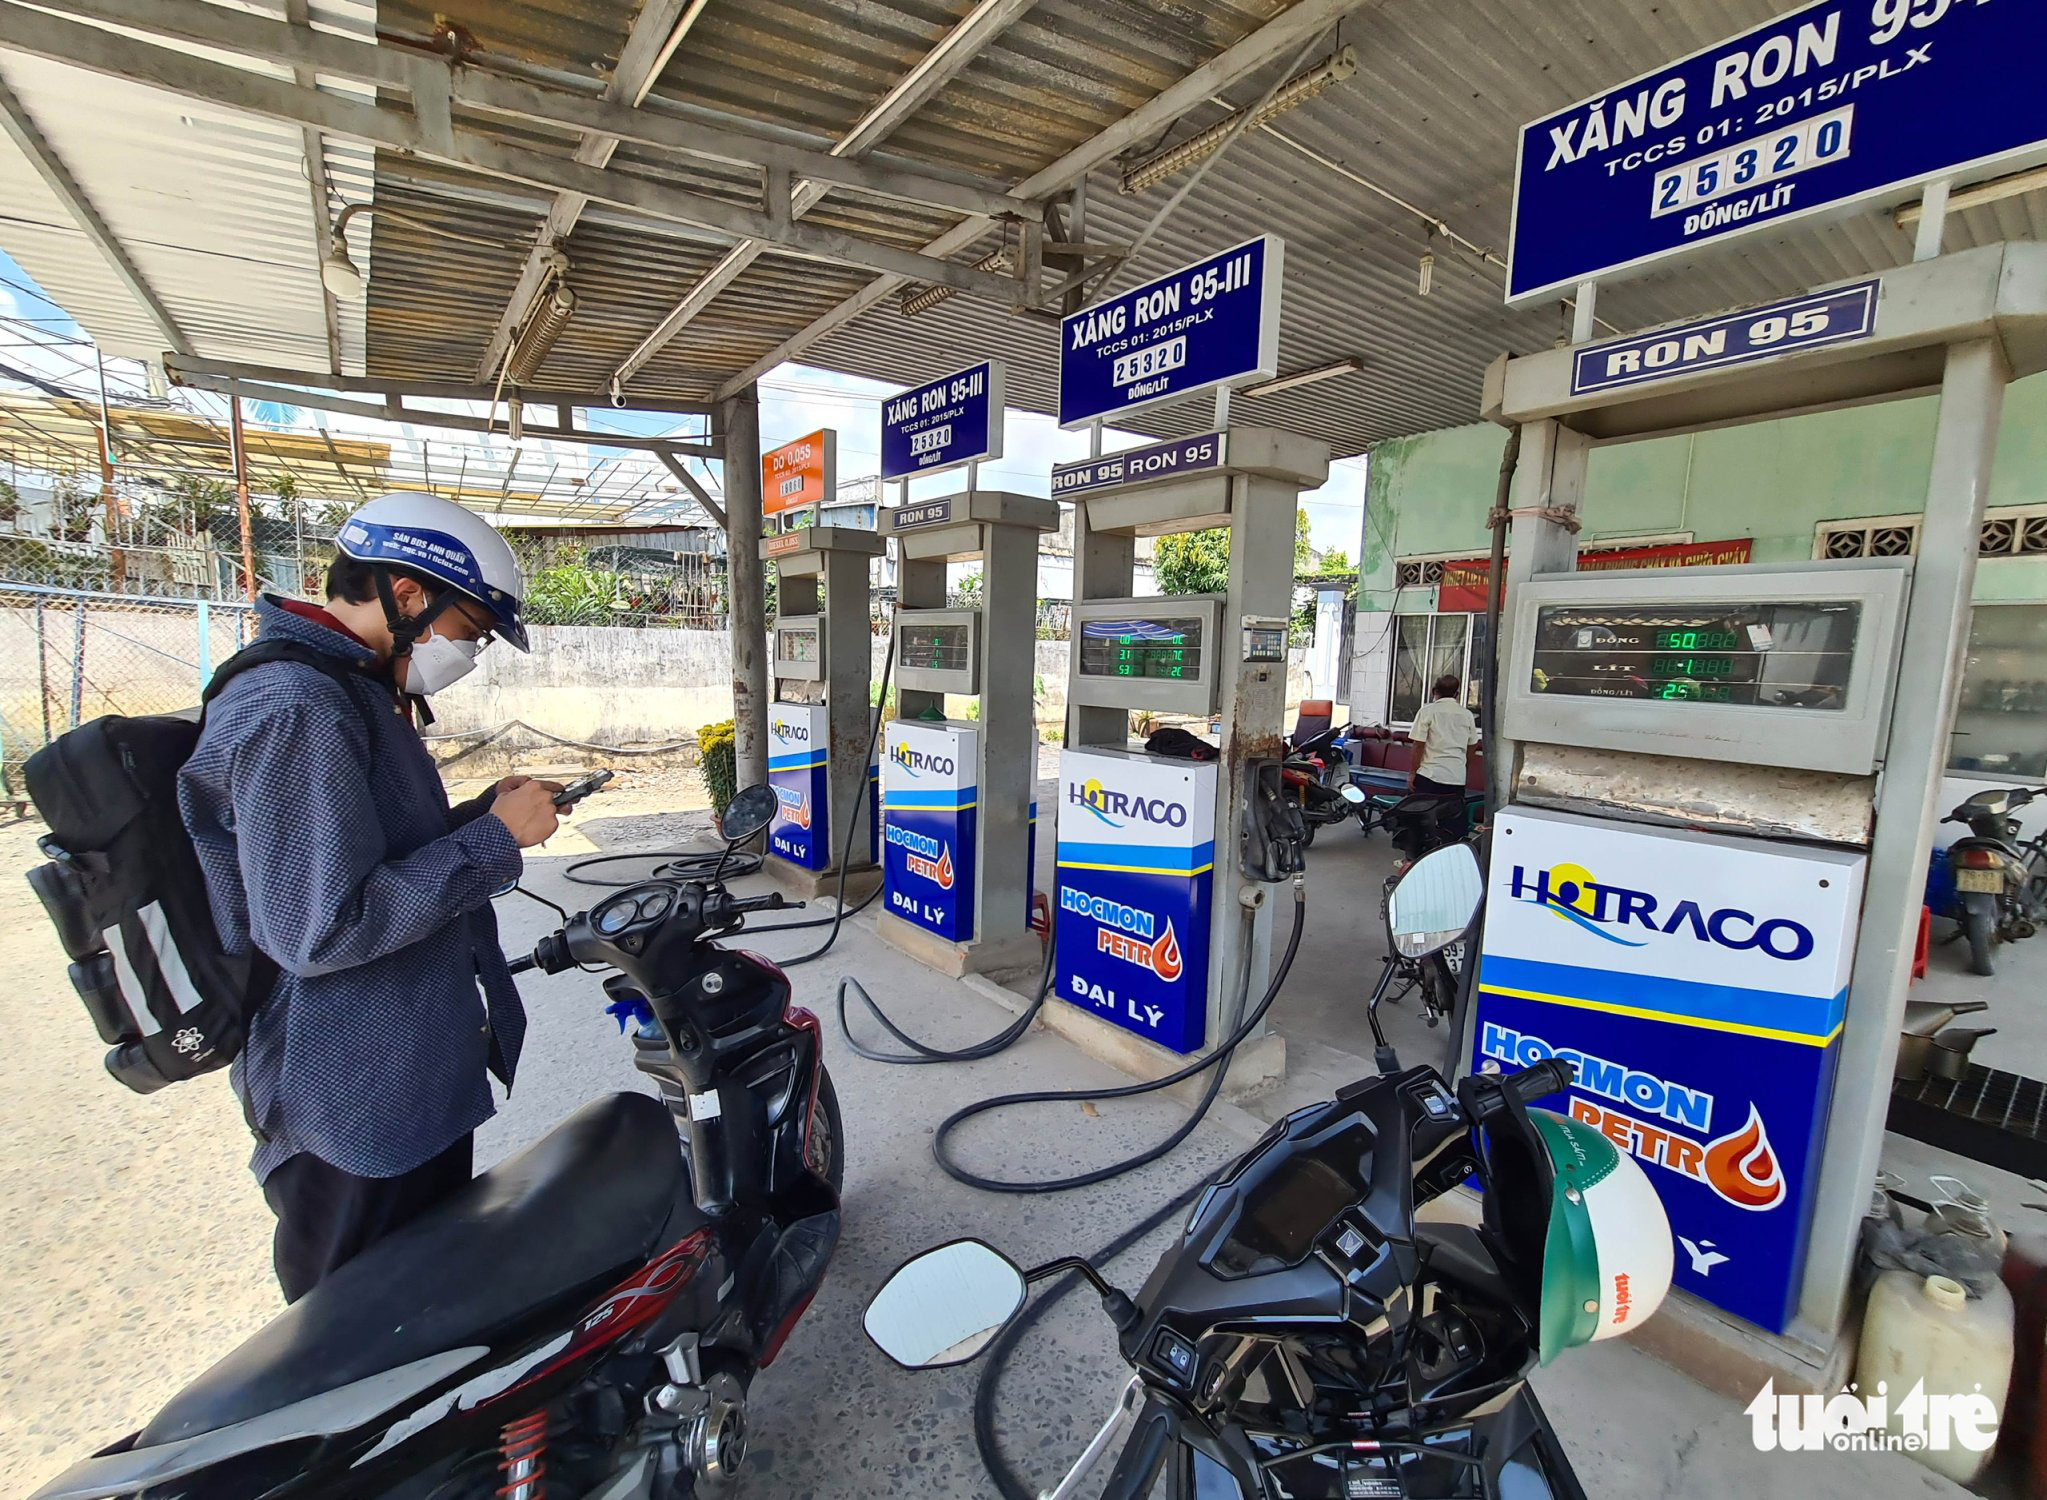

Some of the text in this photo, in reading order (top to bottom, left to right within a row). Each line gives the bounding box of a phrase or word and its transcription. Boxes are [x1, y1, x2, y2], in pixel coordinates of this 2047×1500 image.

[1545, 77, 1688, 172] XĂNG
[1710, 11, 1841, 109] RON
[1603, 41, 1934, 178] TCCS 01: 2015/PLX
[1659, 119, 1843, 209] 25320
[1071, 253, 1251, 351] XĂNG RON 95-III
[1096, 307, 1214, 359] TCCS 01: 2015/PLX
[1604, 306, 1831, 378] RON 95
[1116, 342, 1183, 382] 25320
[887, 371, 984, 427] XĂNG RON 95-III
[901, 421, 919, 434] TCCS
[931, 406, 965, 424] 2015/PLX
[913, 428, 950, 452] 25320
[773, 454, 785, 472] DO
[1052, 463, 1123, 490] RON 95
[1129, 443, 1213, 475] RON 95
[899, 505, 944, 525] RON 95
[427, 543, 446, 556] ANH
[771, 786, 801, 807] OCMON
[793, 844, 807, 859] LÝ
[886, 824, 938, 859] HOCMON
[892, 890, 945, 926] ĐẠI LÝ
[1061, 885, 1155, 939] HOCMON
[1071, 974, 1165, 1029] ĐẠI LÝ
[583, 1303, 615, 1332] 125
